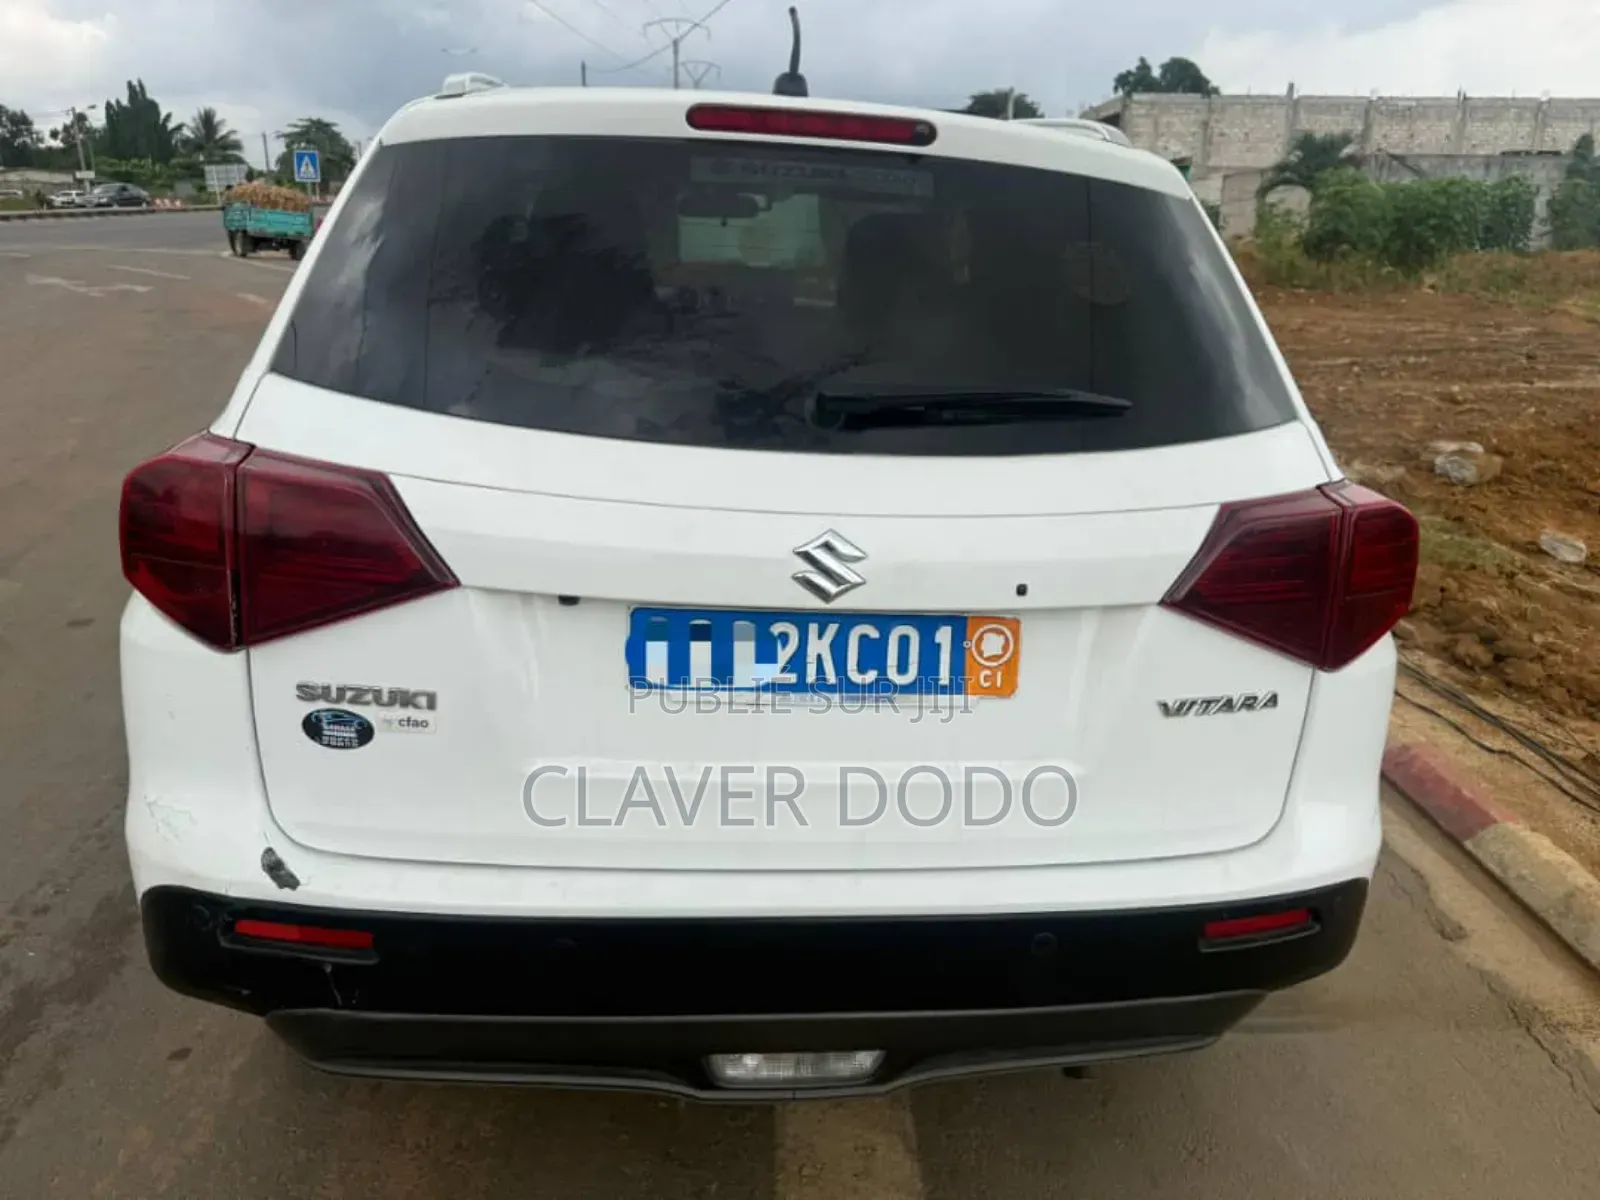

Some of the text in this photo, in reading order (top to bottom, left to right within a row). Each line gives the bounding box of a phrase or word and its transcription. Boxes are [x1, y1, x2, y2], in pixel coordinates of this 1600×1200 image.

[646, 618, 953, 687] 2KC01
[296, 681, 437, 710] SUZUKI
[1158, 691, 1279, 717] VITARA
[398, 716, 429, 729] cfao
